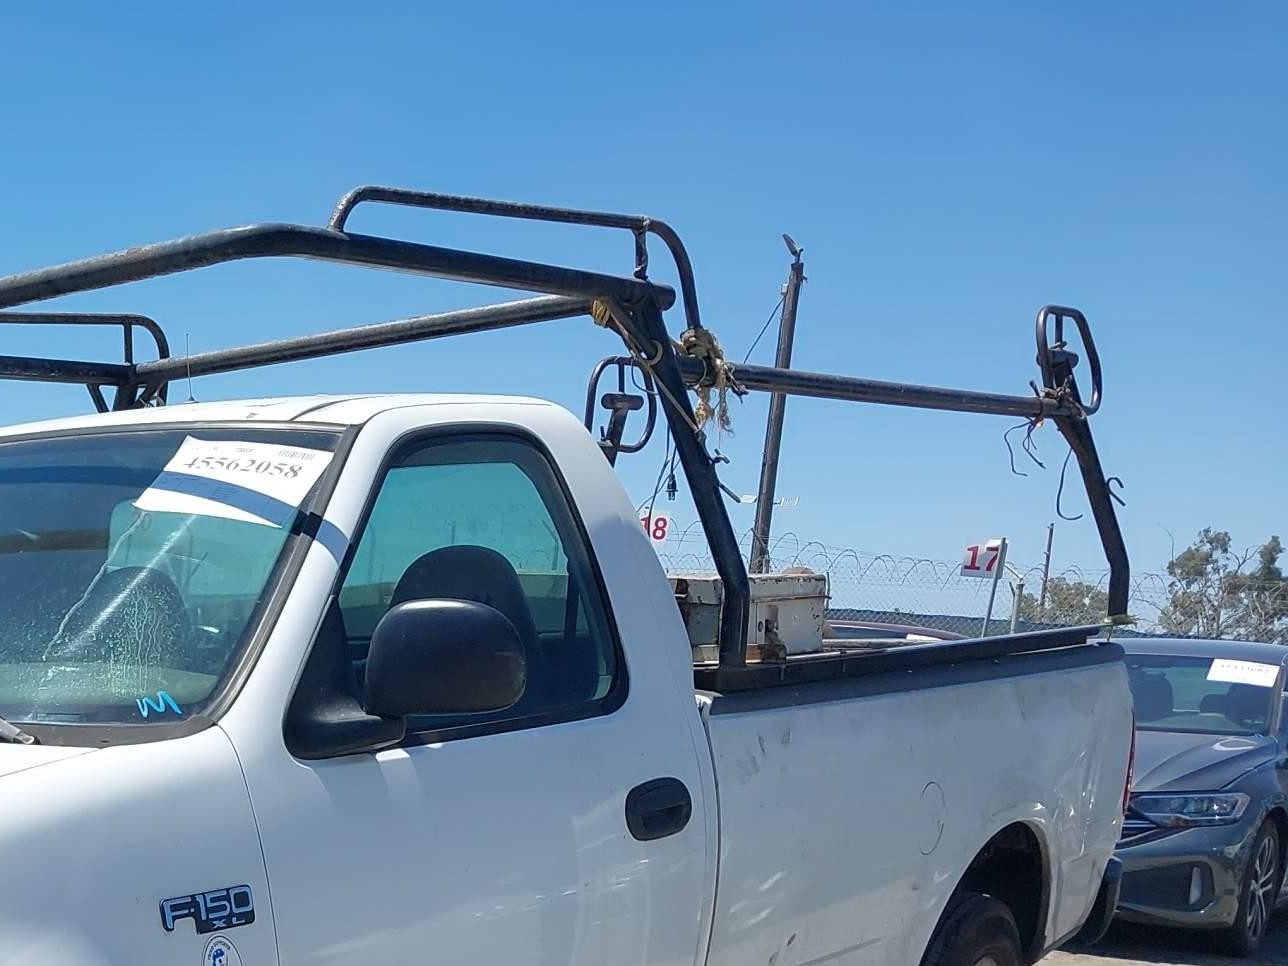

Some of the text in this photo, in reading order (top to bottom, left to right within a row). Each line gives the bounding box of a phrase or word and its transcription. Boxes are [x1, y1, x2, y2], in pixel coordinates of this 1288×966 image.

[184, 456, 303, 479] 45562058
[963, 545, 1000, 572] 17
[212, 916, 246, 929] XL
